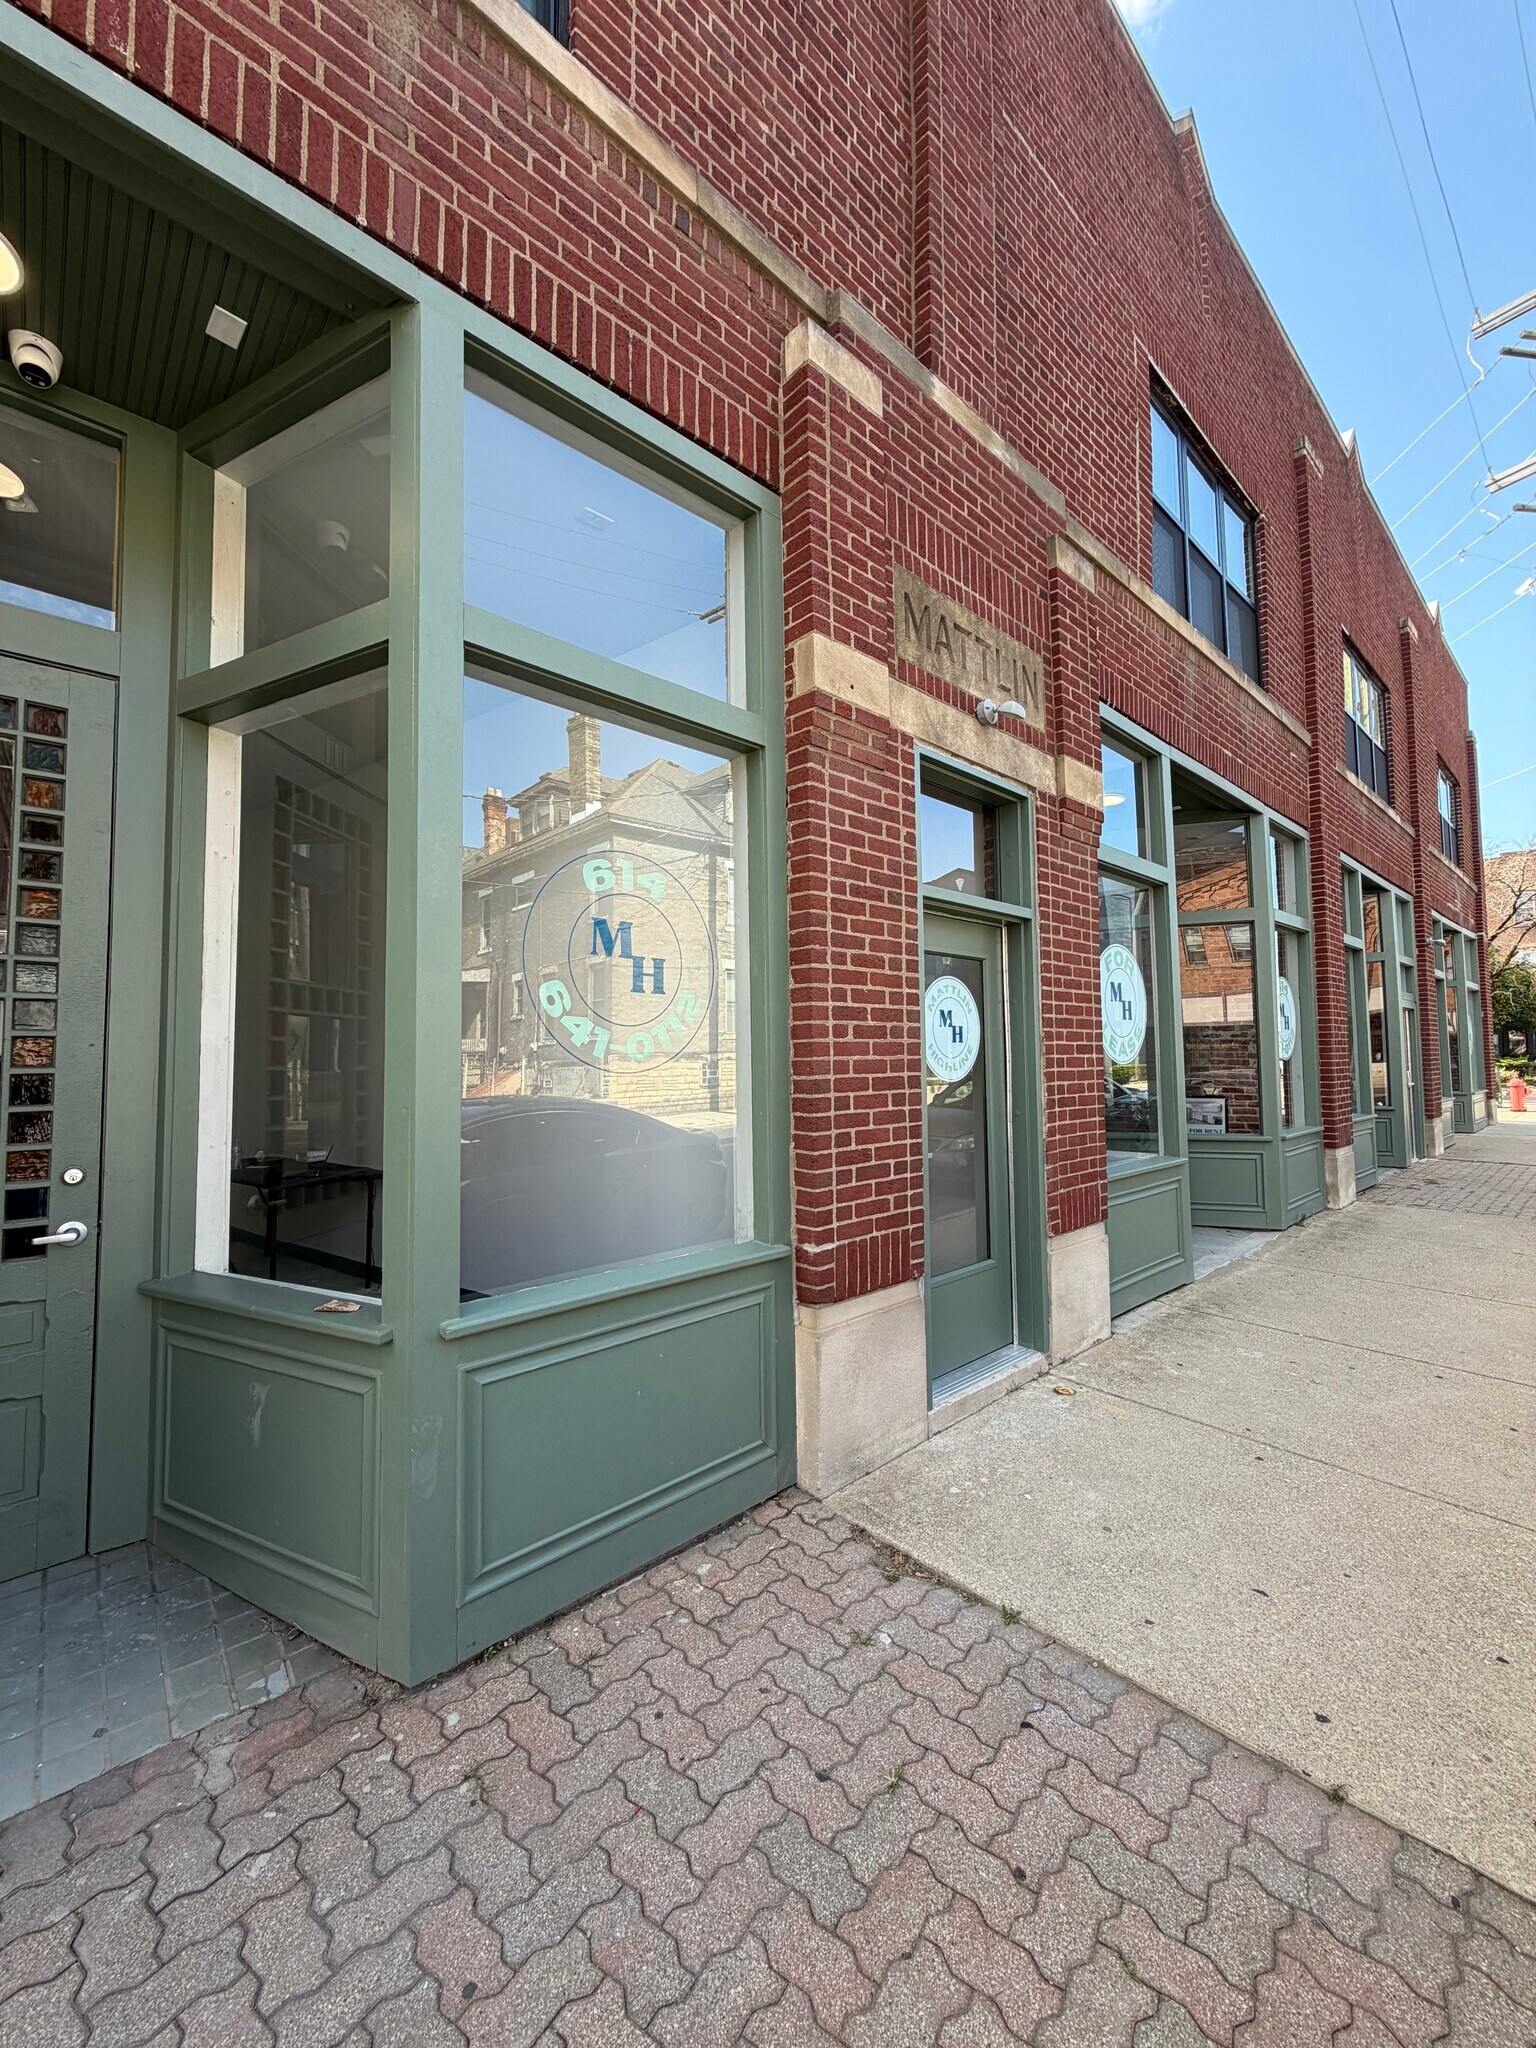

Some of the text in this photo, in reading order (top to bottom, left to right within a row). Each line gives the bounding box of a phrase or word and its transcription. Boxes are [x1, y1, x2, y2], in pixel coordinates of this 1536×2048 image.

[903, 591, 1040, 711] MATTLIN
[582, 858, 668, 902] 614
[1104, 950, 1135, 977] FOR
[927, 984, 973, 1015] MATTLIN
[538, 979, 702, 1064] 641-0112
[928, 1043, 974, 1073] HIGHLINE
